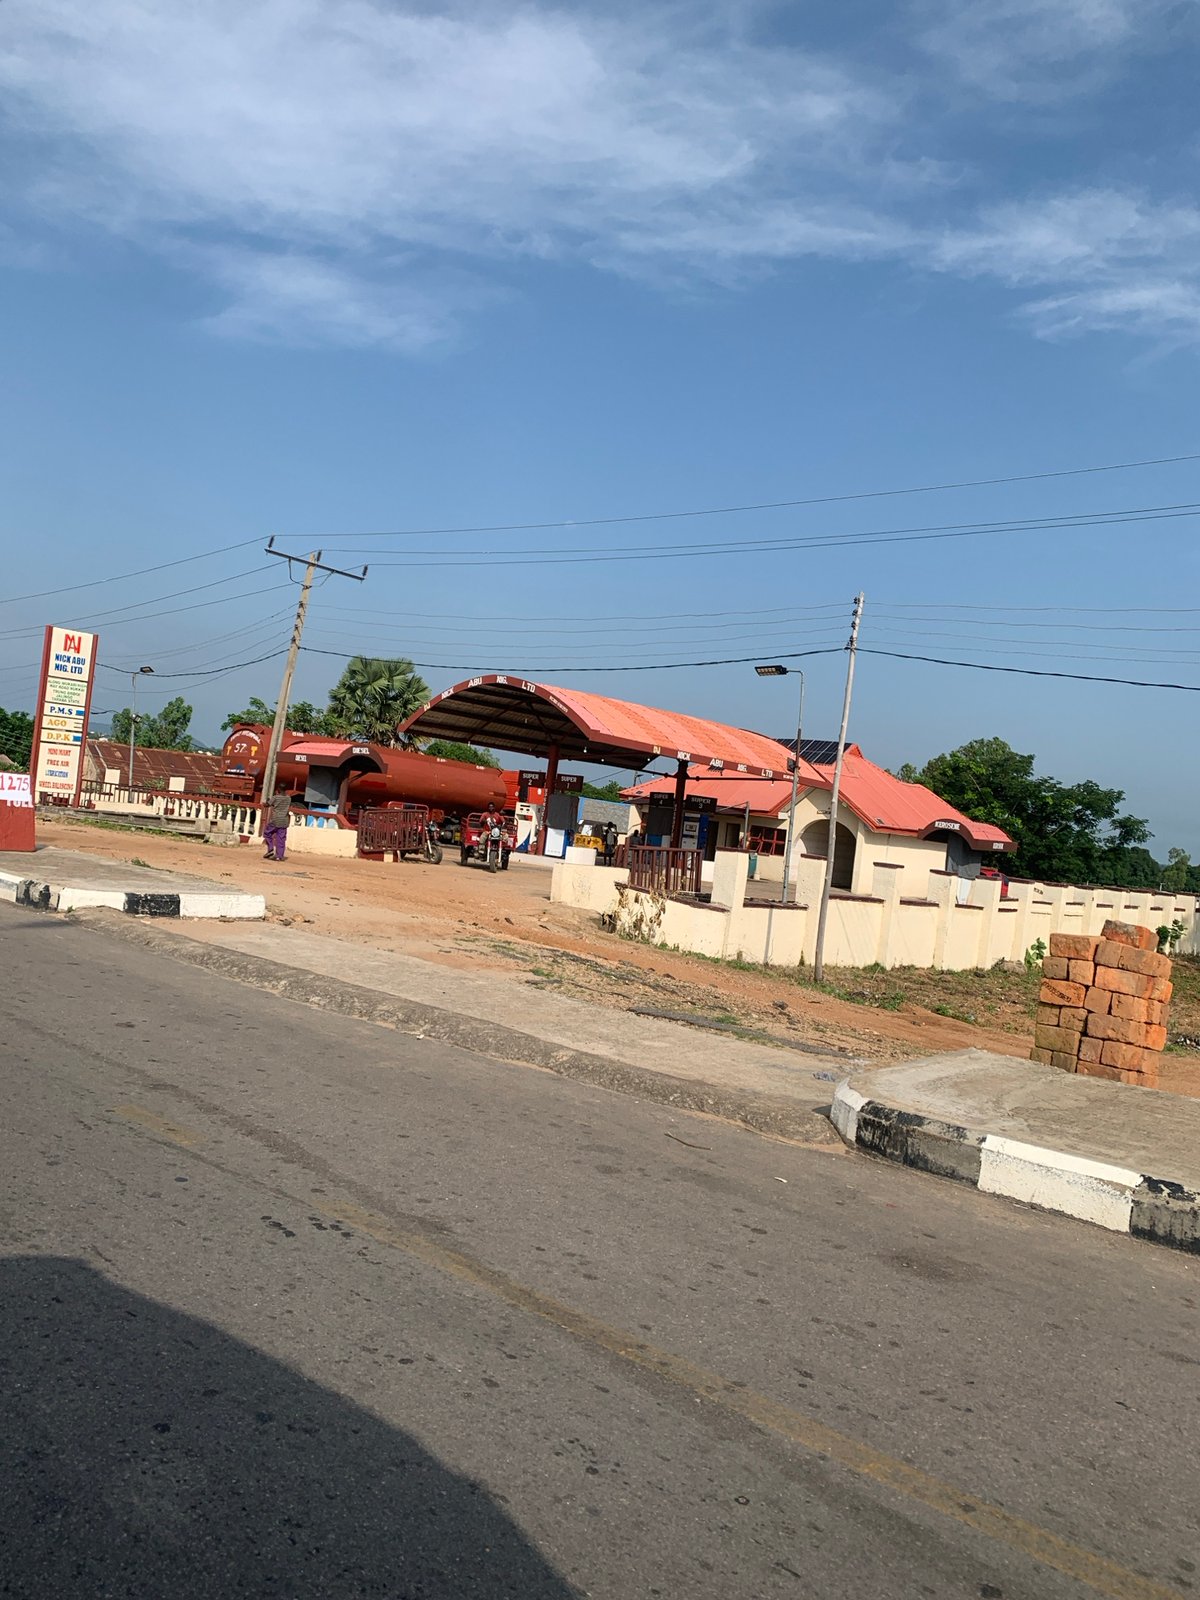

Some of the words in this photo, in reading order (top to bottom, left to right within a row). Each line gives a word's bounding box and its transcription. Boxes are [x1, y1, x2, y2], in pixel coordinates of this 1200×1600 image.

[55, 654, 71, 664] NICK
[72, 656, 86, 666] ABU
[54, 663, 69, 673] NIG.
[70, 665, 83, 675] LTD
[441, 687, 454, 700] NICK
[467, 677, 483, 688] ABU
[521, 681, 536, 693] LTD
[49, 705, 73, 715] P.M.S
[47, 718, 67, 727] AGO
[46, 732, 71, 741] D.P.K
[352, 747, 370, 755] DIESEL
[46, 759, 59, 767] FREE
[652, 745, 661, 754] DJ
[677, 751, 691, 761] NICK
[709, 758, 724, 768] ABU
[761, 769, 773, 778] LTD
